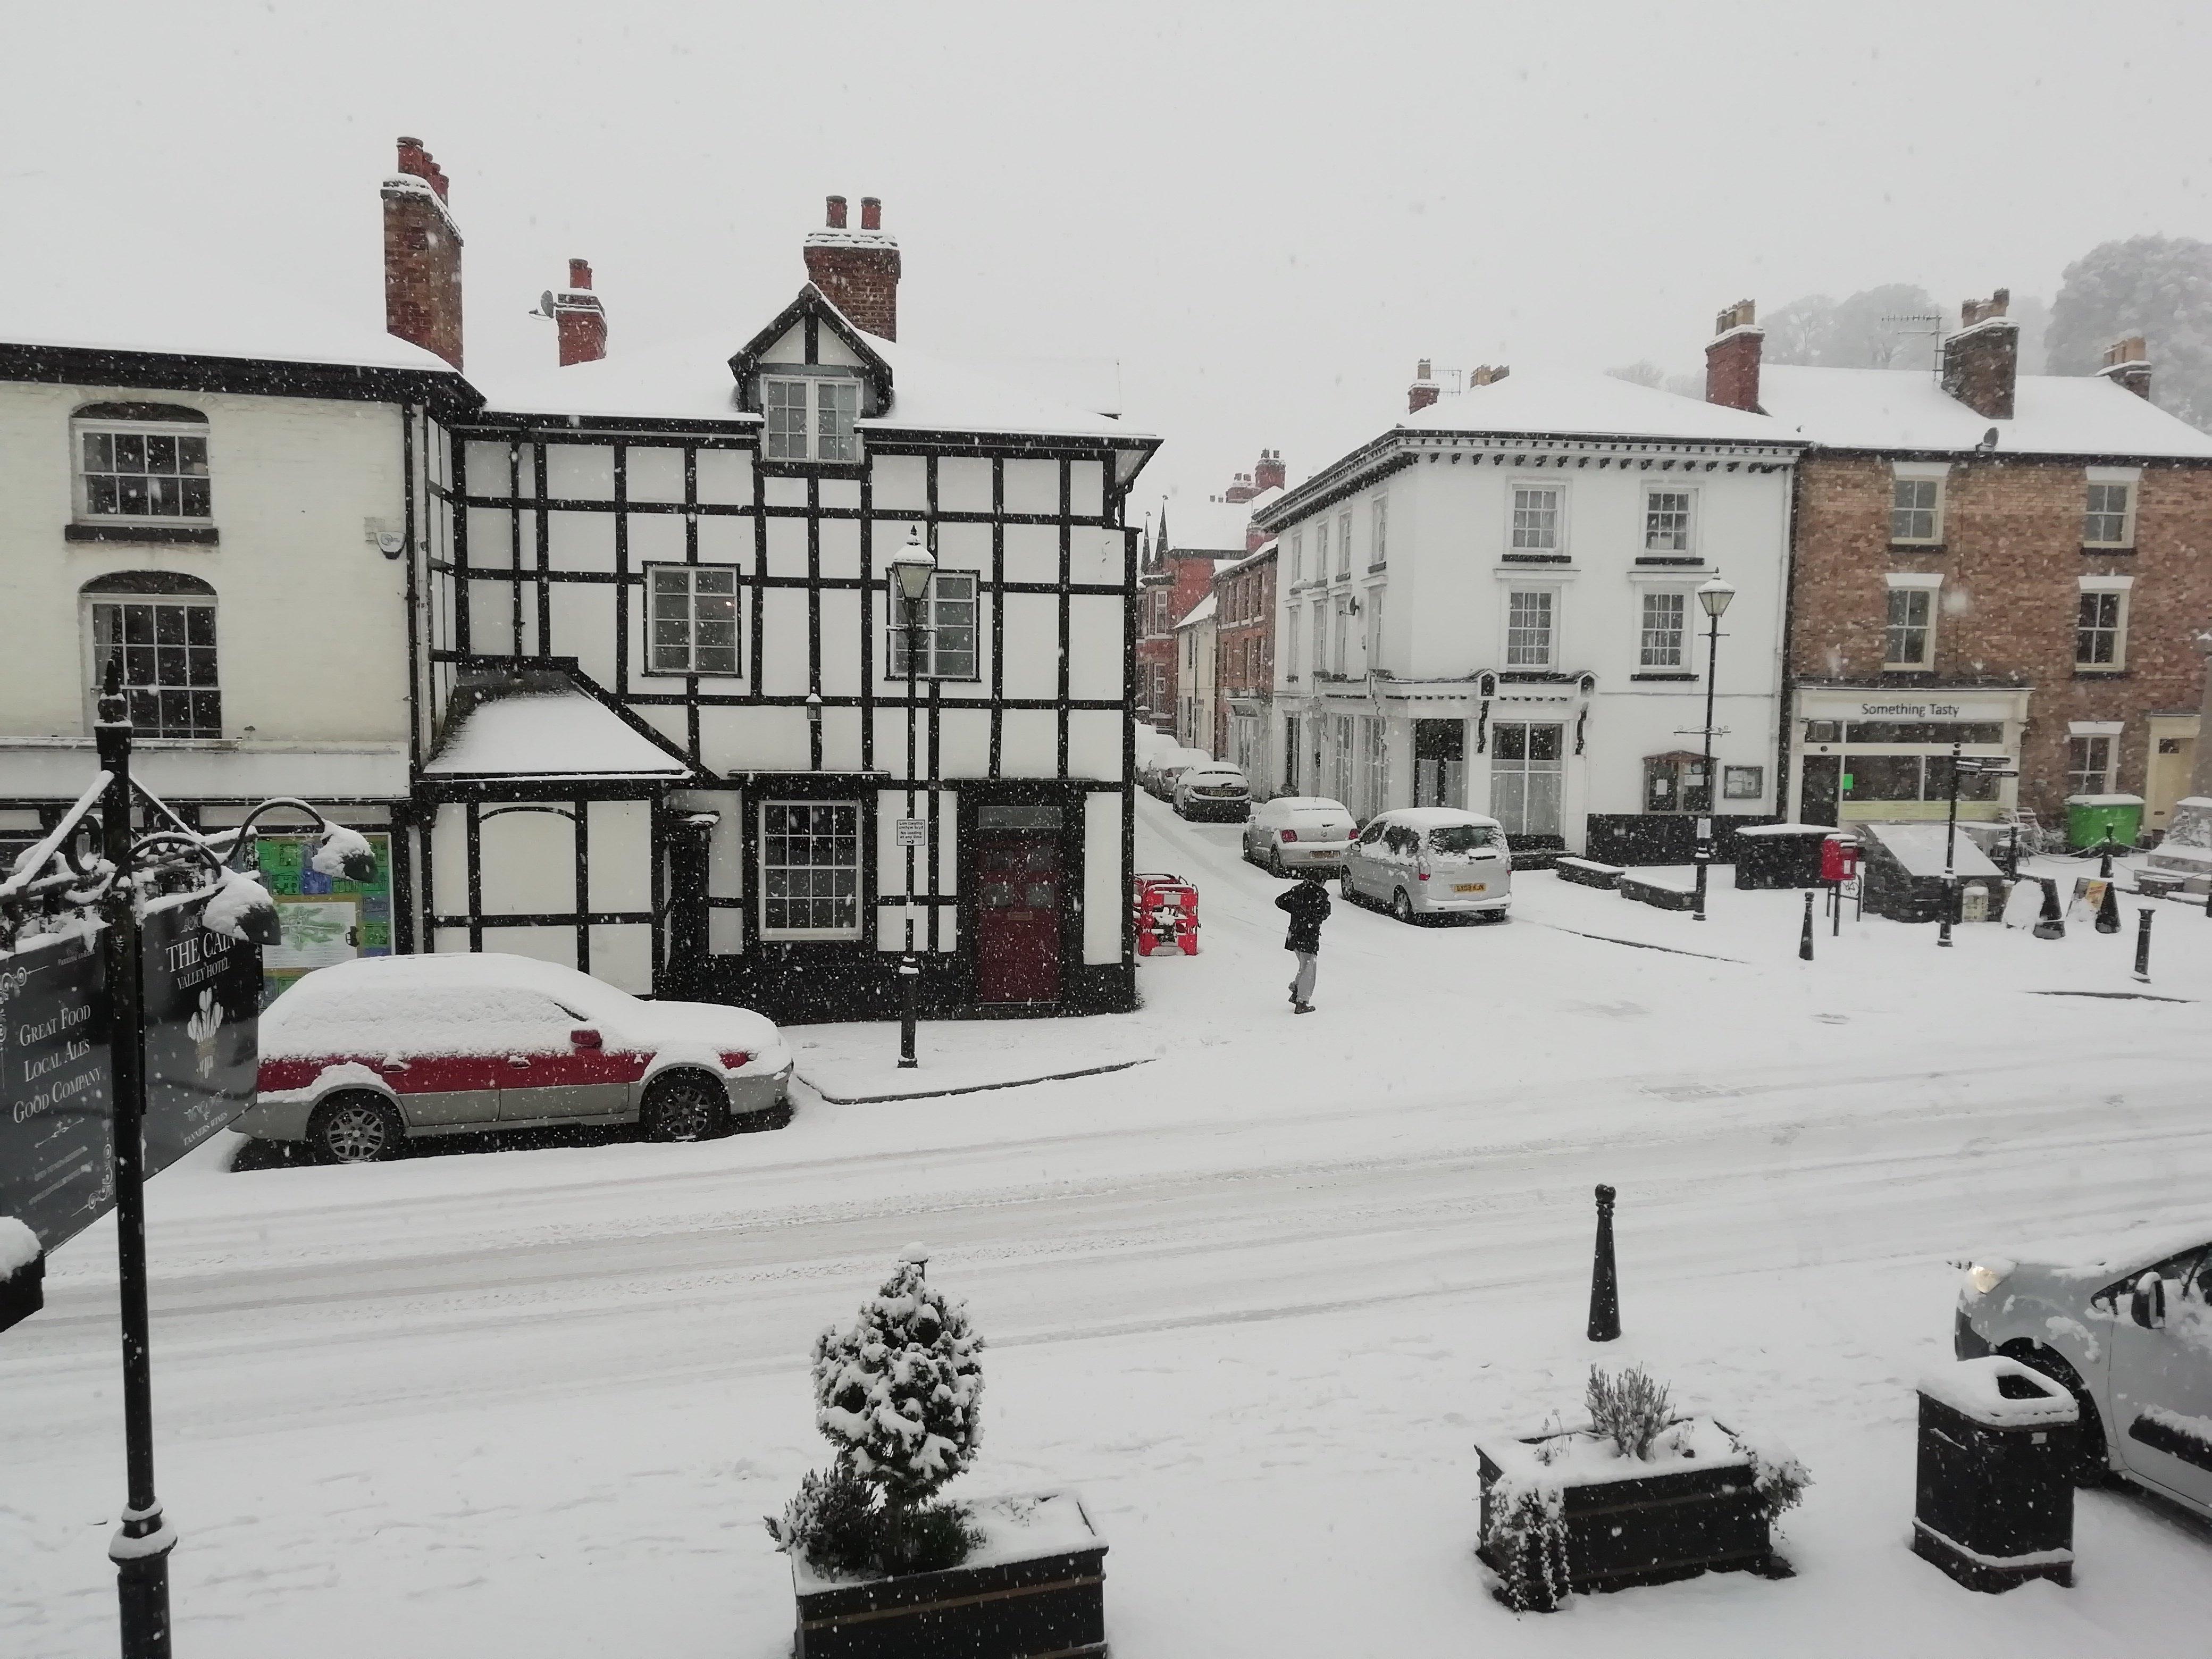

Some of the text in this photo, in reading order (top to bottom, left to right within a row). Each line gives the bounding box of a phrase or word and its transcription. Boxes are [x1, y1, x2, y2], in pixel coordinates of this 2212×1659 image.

[1862, 703, 1959, 717] Something Tasty
[165, 937, 200, 973] THE
[177, 957, 230, 990] VALLEY HOTEL
[20, 1005, 90, 1046] GREAT FOOD
[23, 1052, 62, 1082] LOCAL
[14, 1094, 49, 1123] GOOD
